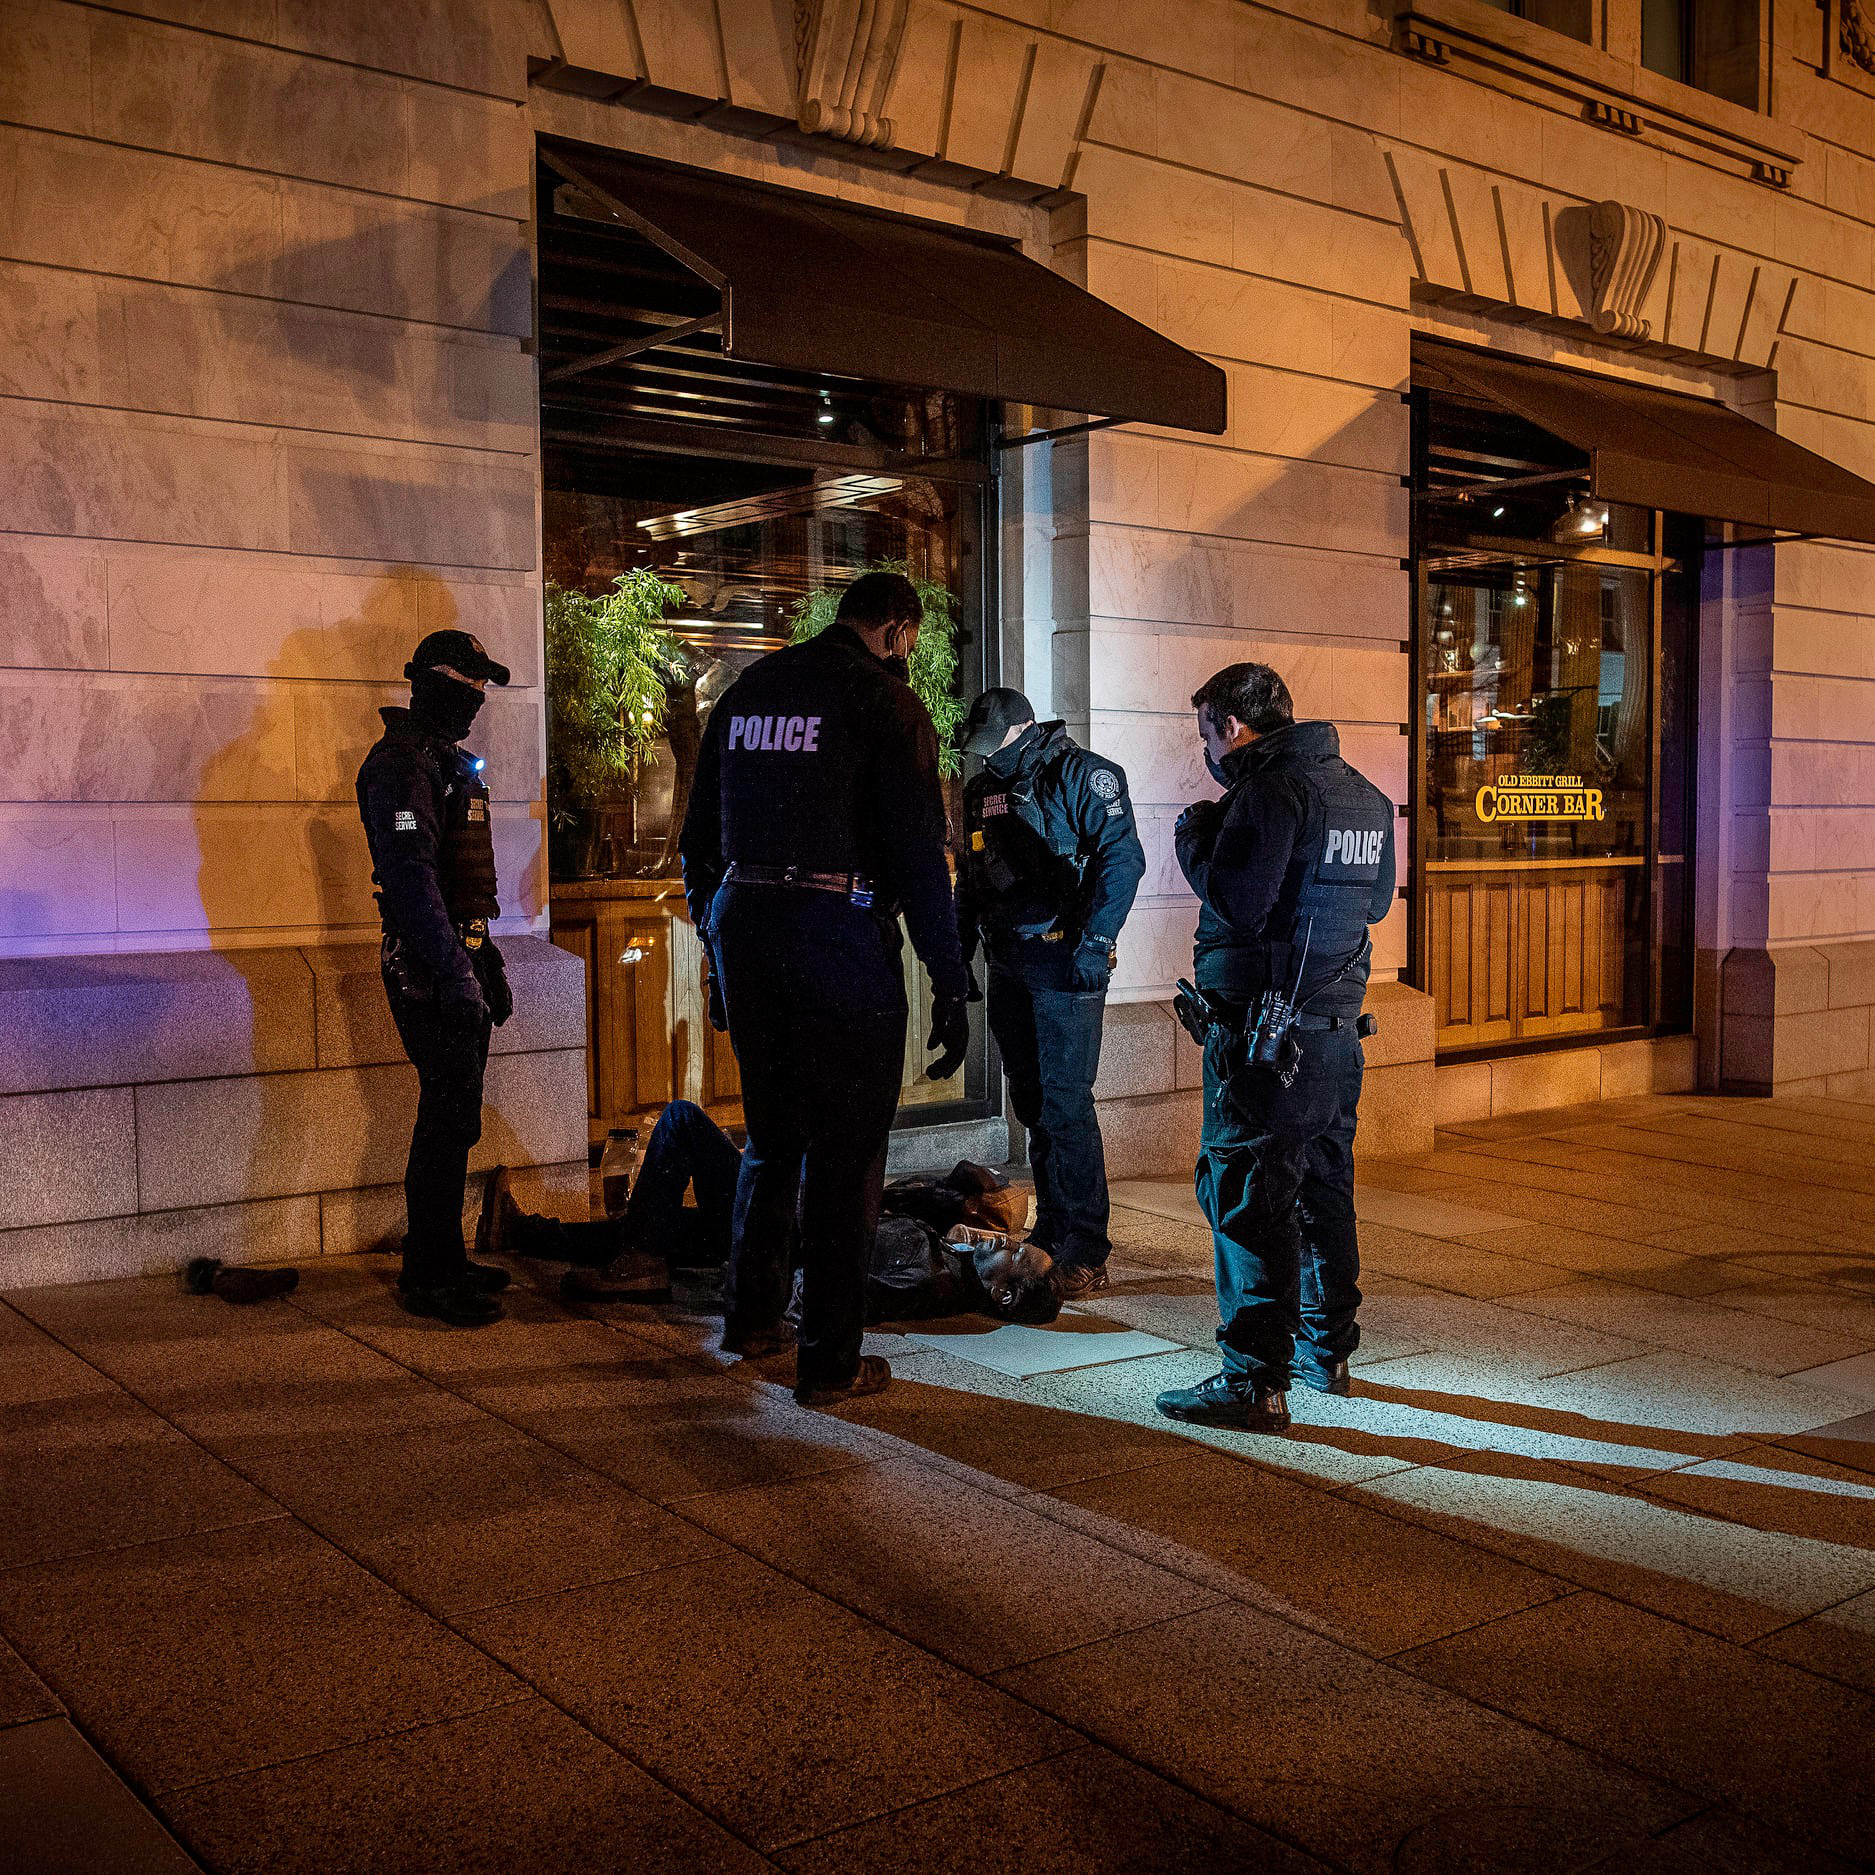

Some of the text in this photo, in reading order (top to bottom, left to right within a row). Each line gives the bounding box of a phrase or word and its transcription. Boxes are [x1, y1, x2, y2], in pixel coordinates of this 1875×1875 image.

[728, 715, 822, 752] POLICE
[1498, 774, 1584, 788] OLD EBBITT GRILL
[1475, 785, 1605, 823] CORNER BAR
[395, 811, 415, 821] SECRET
[395, 821, 417, 831] SERVICE
